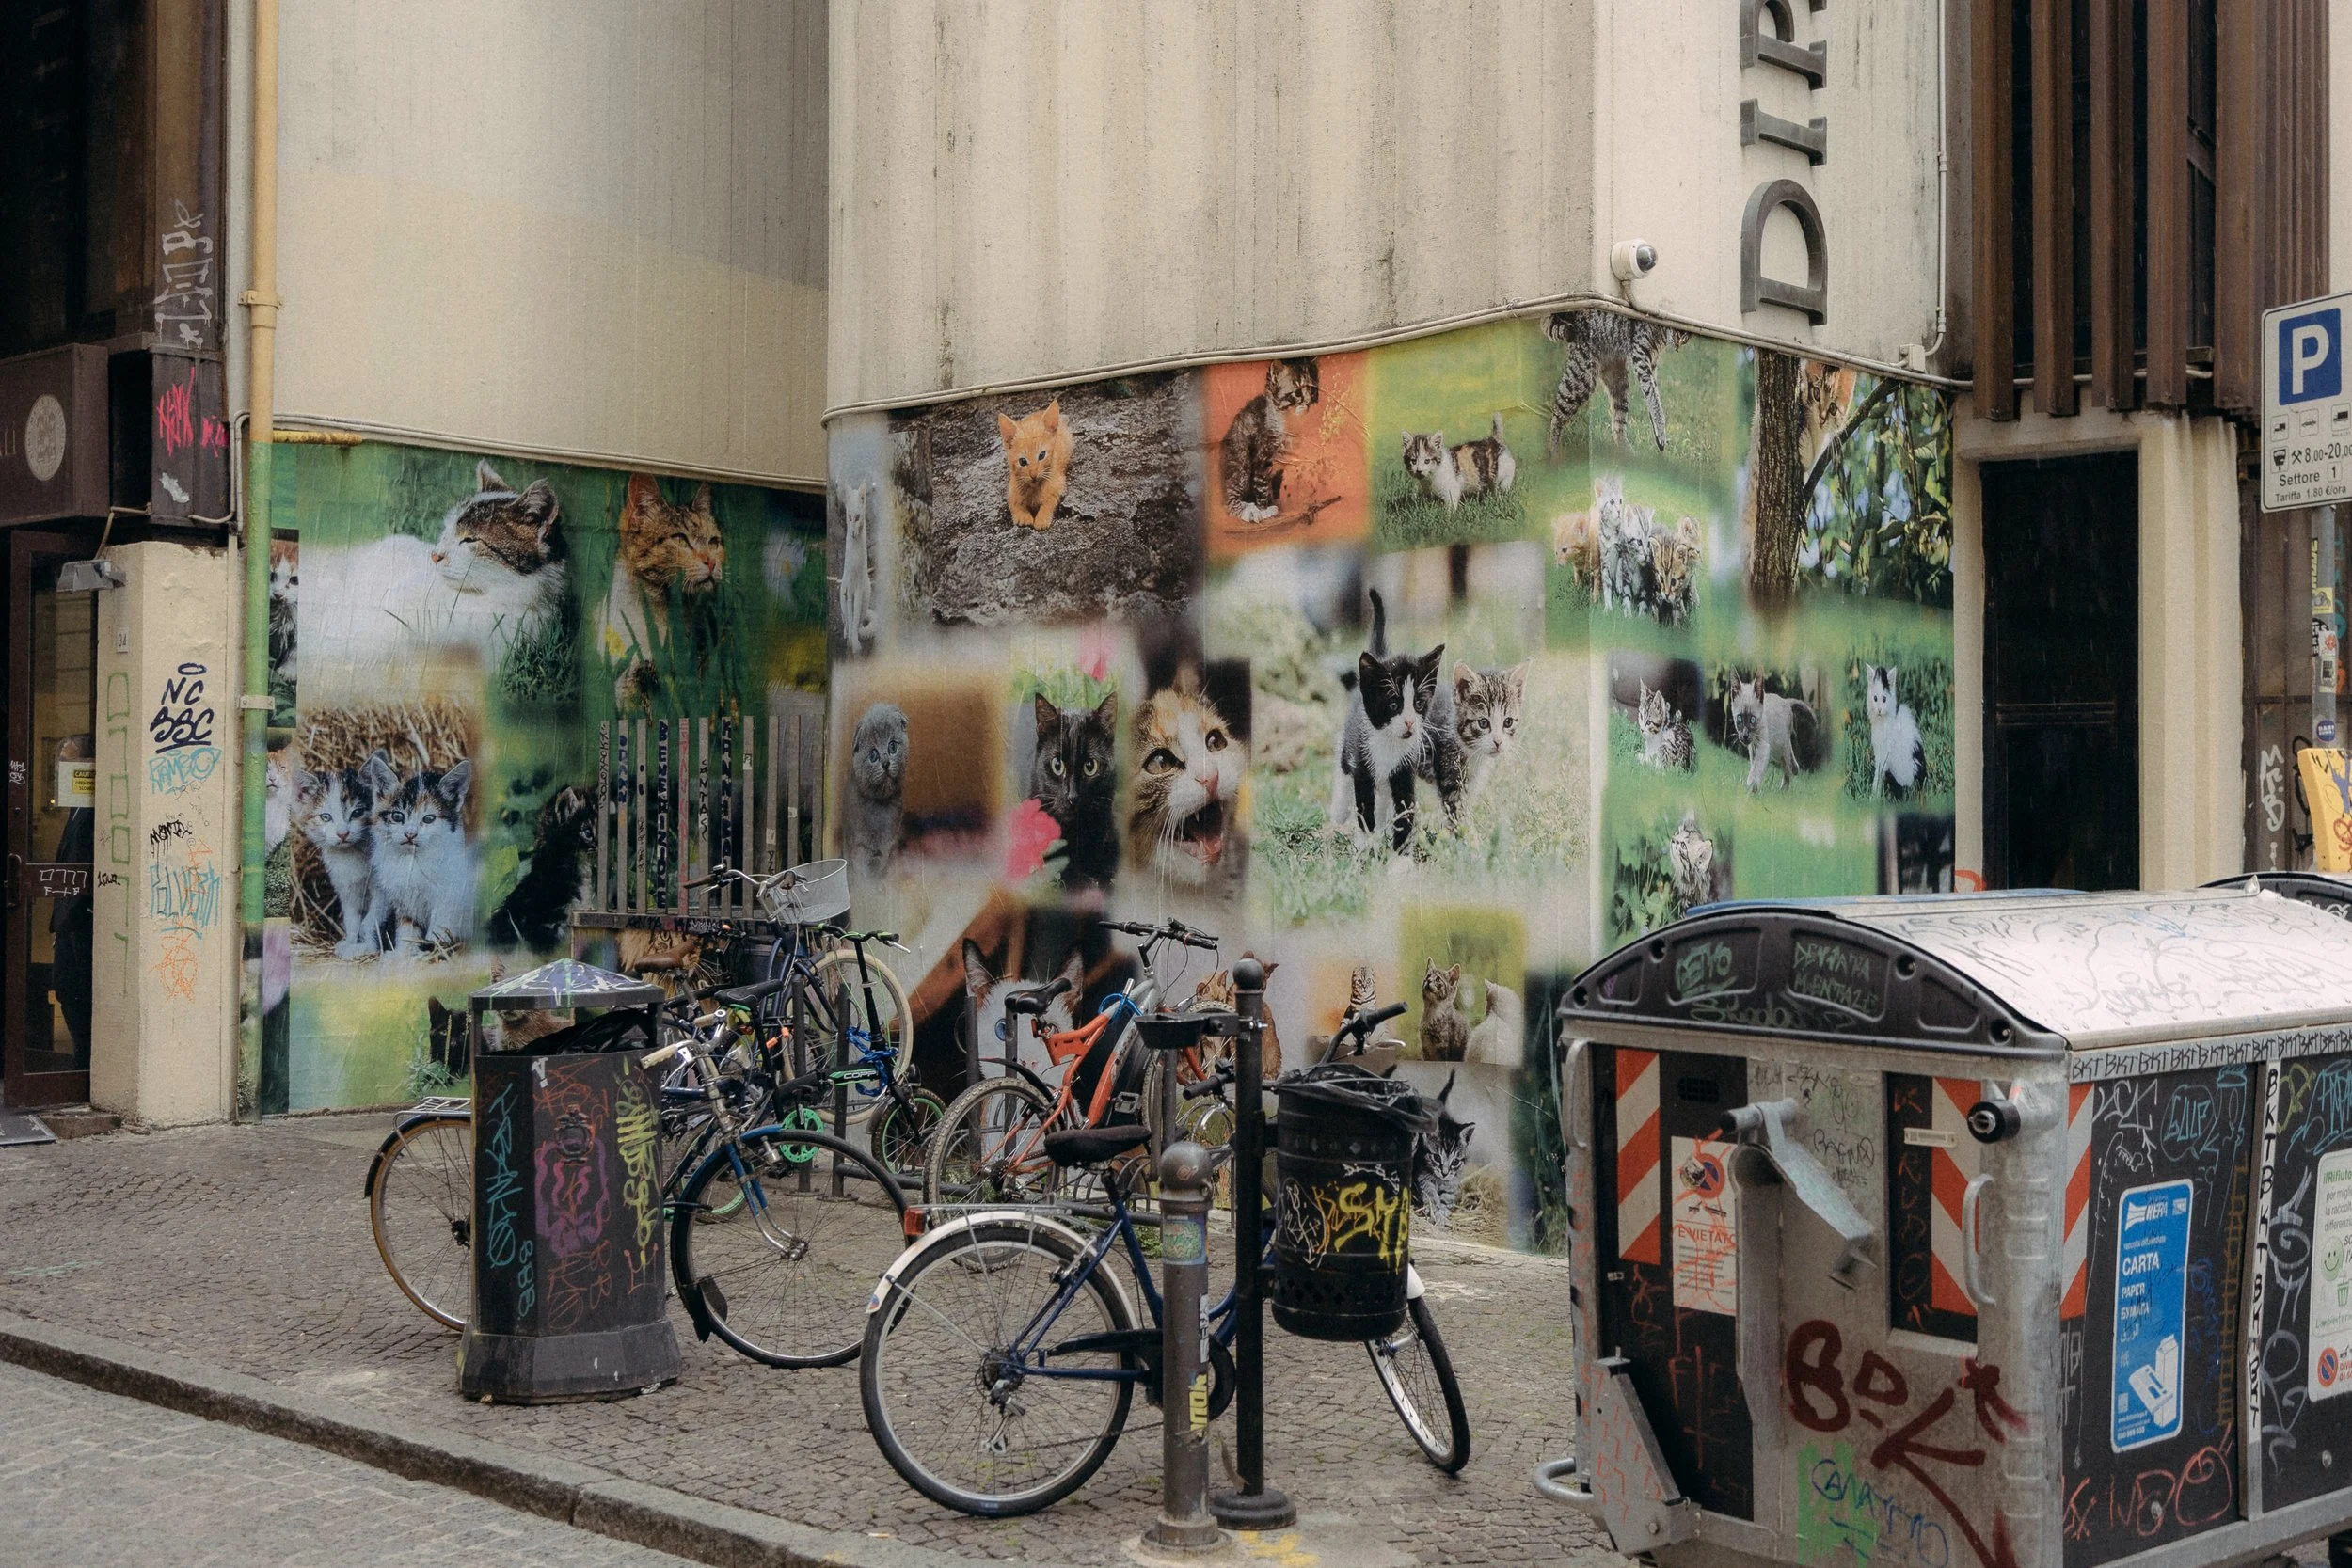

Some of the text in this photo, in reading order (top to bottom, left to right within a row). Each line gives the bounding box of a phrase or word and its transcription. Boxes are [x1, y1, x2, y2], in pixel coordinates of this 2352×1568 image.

[2292, 325, 2329, 395] P
[2280, 467, 2336, 486] Settore 1
[2275, 491, 2301, 502] Tariffa
[2122, 1251, 2160, 1277] CARTA
[2122, 1282, 2146, 1299] PAPER
